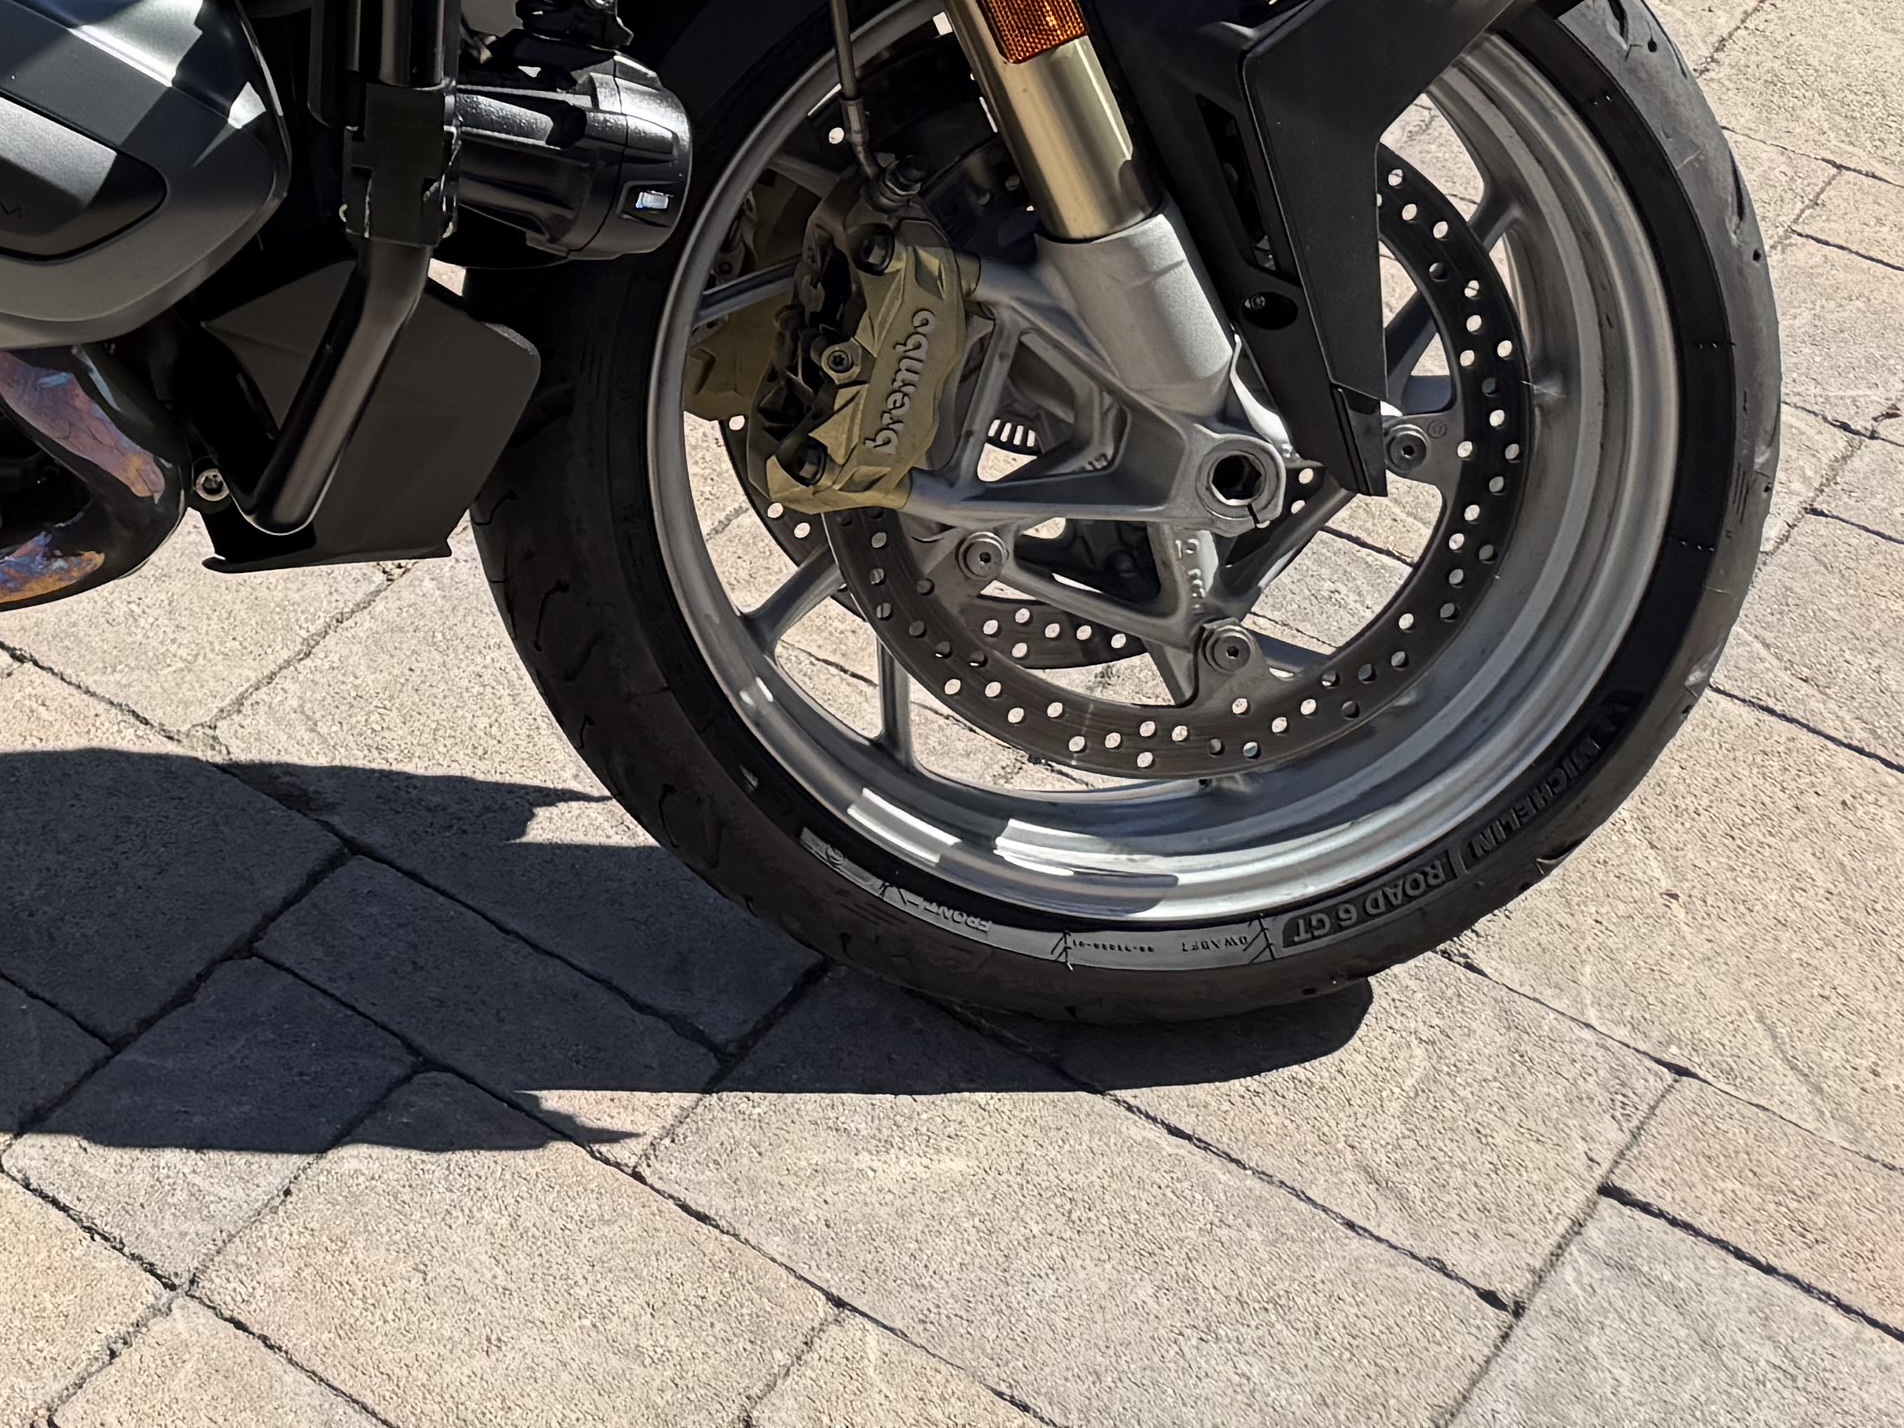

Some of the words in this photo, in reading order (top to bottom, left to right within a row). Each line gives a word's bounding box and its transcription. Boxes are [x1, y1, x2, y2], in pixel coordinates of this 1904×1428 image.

[864, 309, 937, 457] brembo
[1471, 738, 1602, 859] MICHELIN
[1336, 906, 1359, 926] 6
[1364, 858, 1446, 916] ROAD
[1293, 910, 1332, 942] GT
